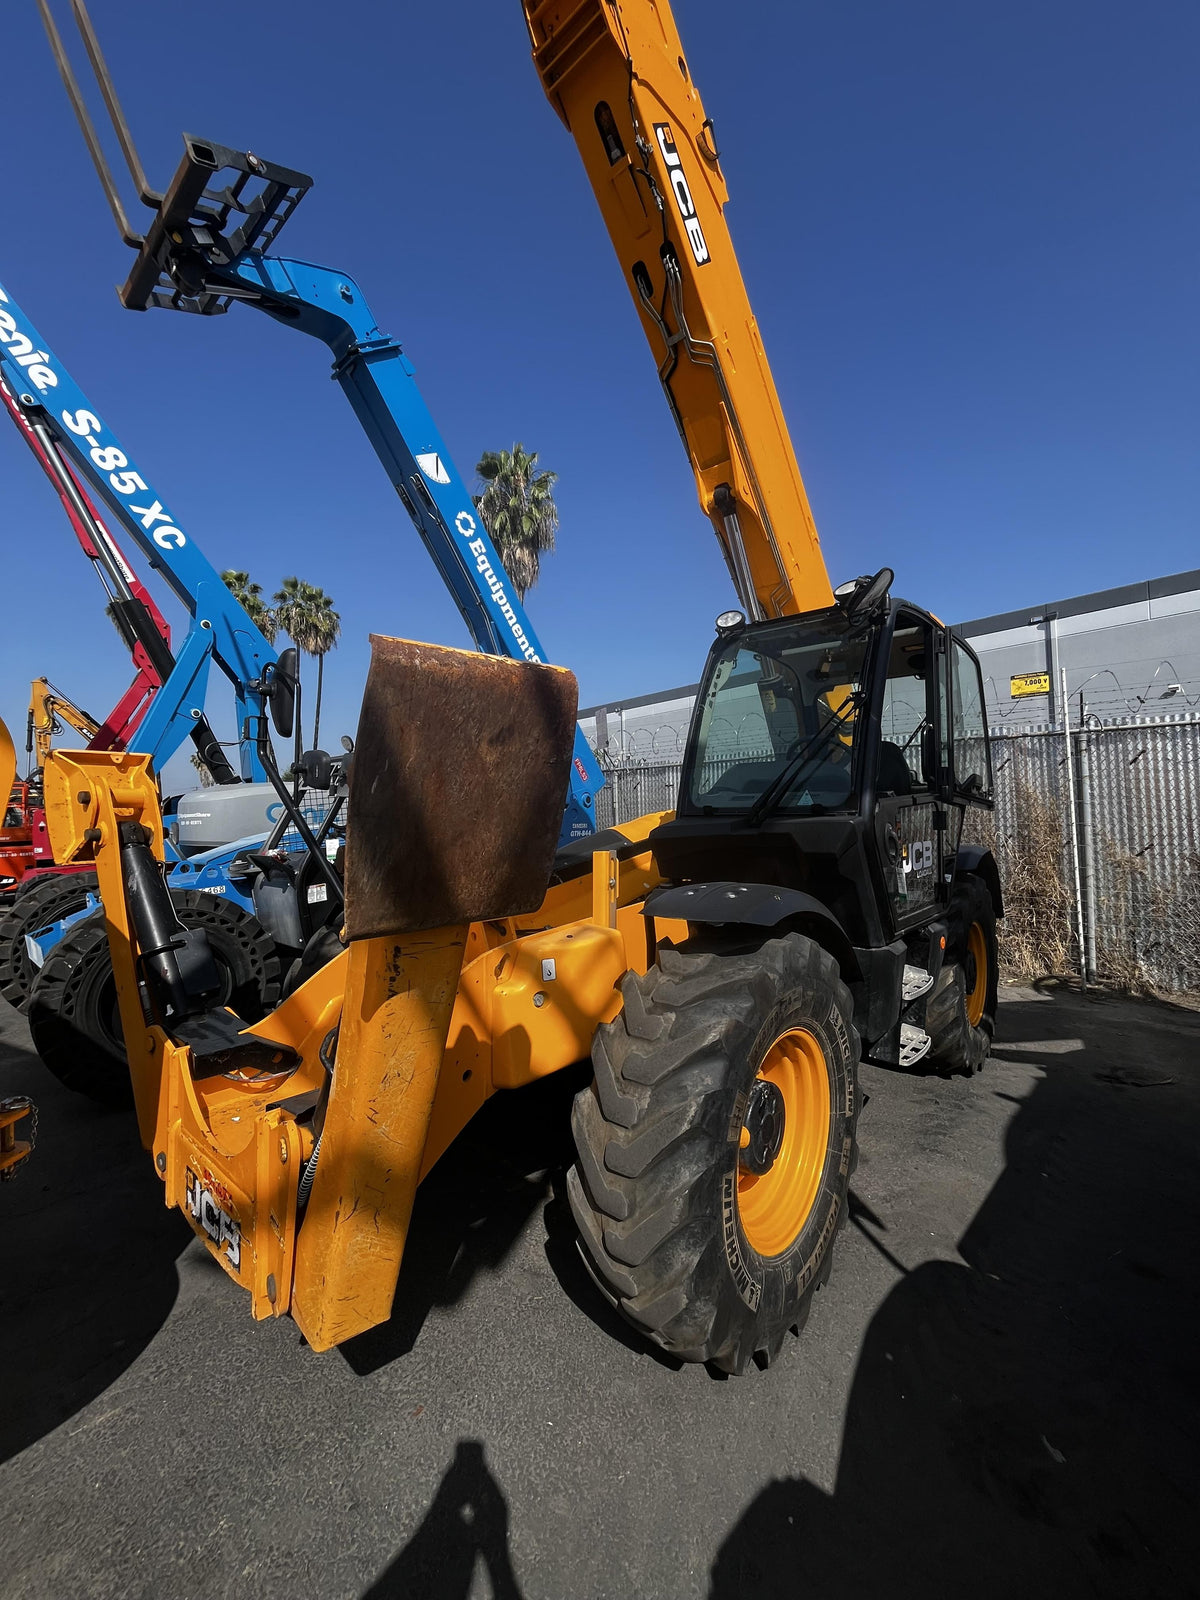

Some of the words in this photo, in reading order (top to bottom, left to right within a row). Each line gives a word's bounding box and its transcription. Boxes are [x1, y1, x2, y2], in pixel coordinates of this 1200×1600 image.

[656, 126, 709, 263] JCB
[0, 288, 58, 390] enie
[62, 409, 148, 494] S-85
[128, 500, 186, 550] XC
[903, 841, 932, 873] JCB
[186, 1176, 240, 1265] JCB
[723, 1178, 750, 1295] MICHELIN
